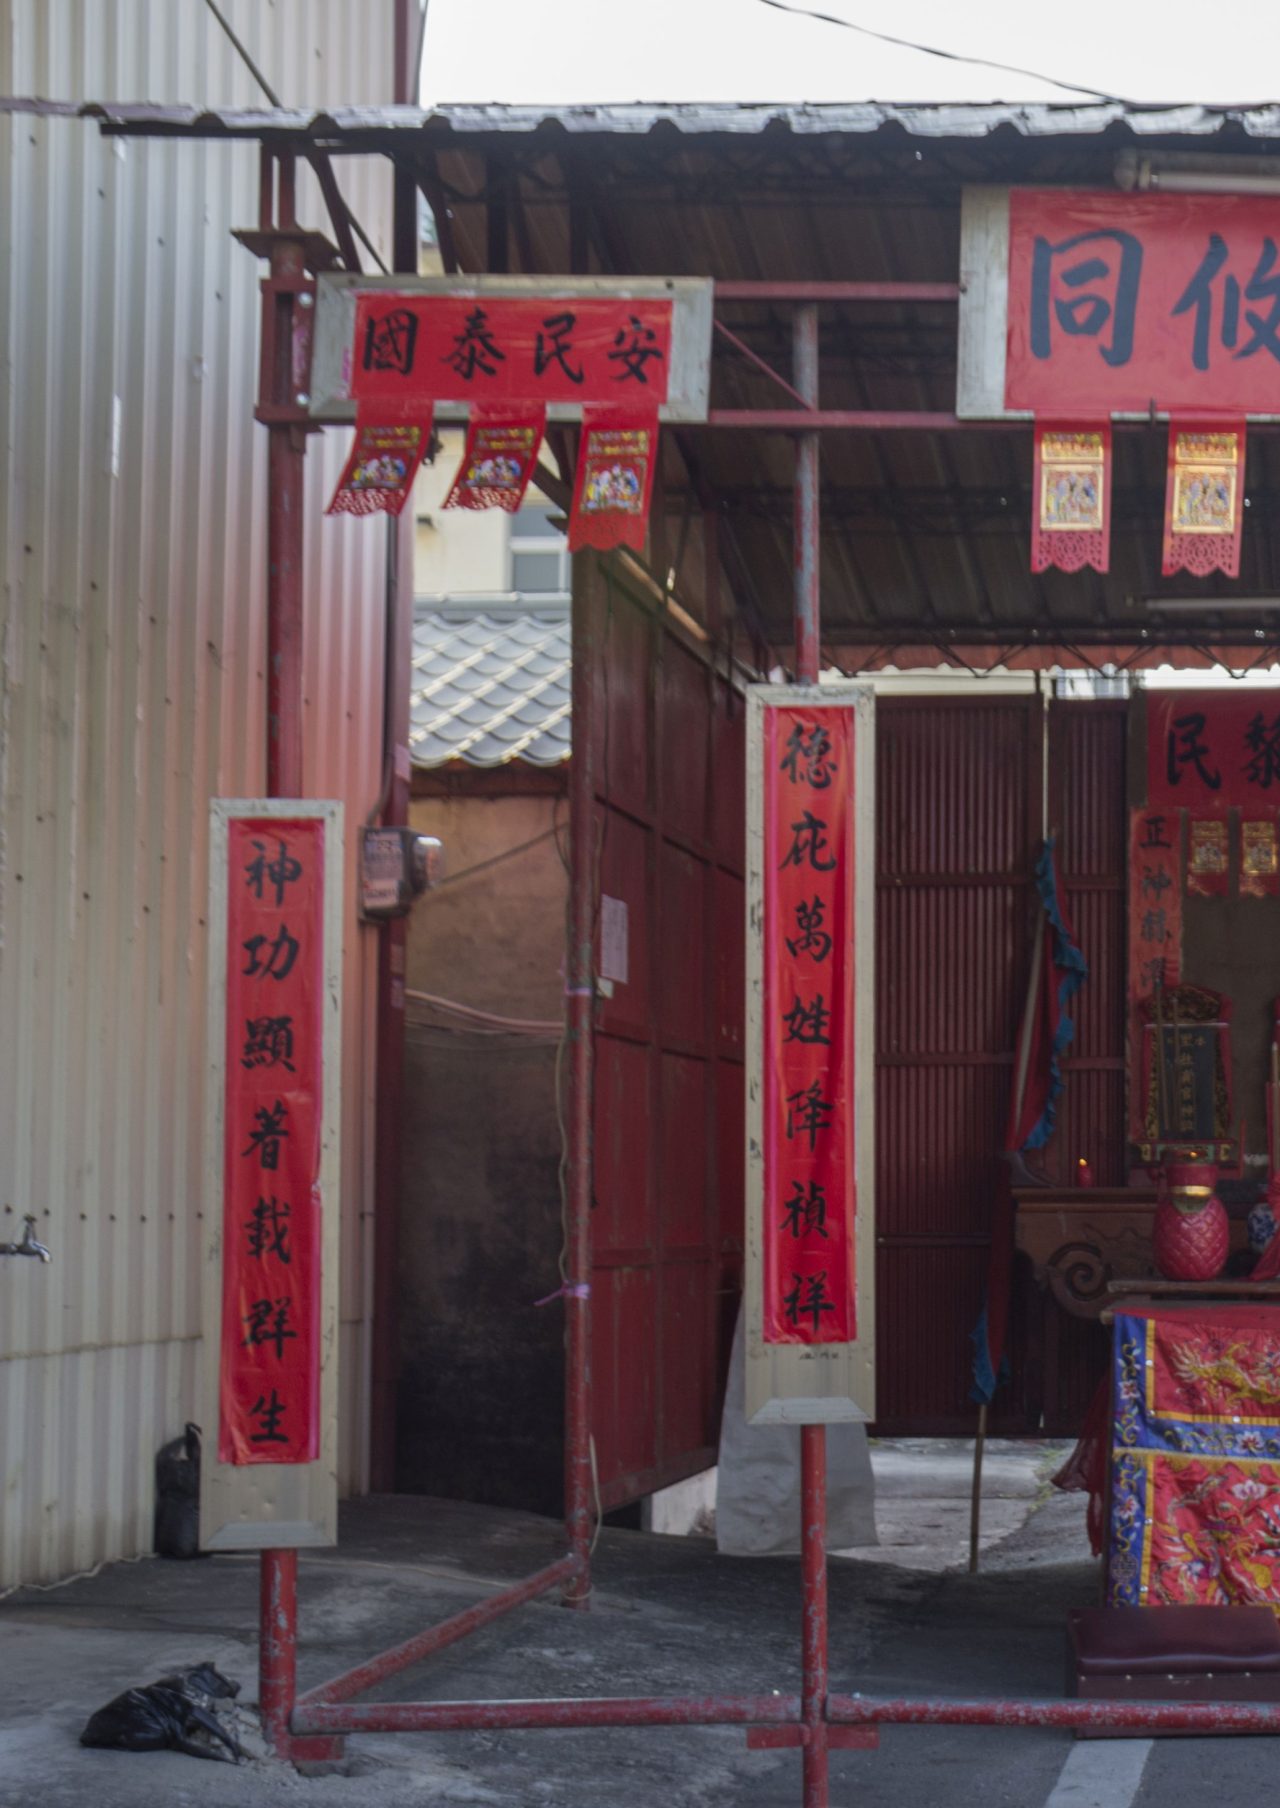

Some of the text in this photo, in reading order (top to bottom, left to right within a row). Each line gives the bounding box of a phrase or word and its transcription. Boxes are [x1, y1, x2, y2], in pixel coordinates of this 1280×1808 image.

[239, 840, 303, 1445] 神功顯著載群生
